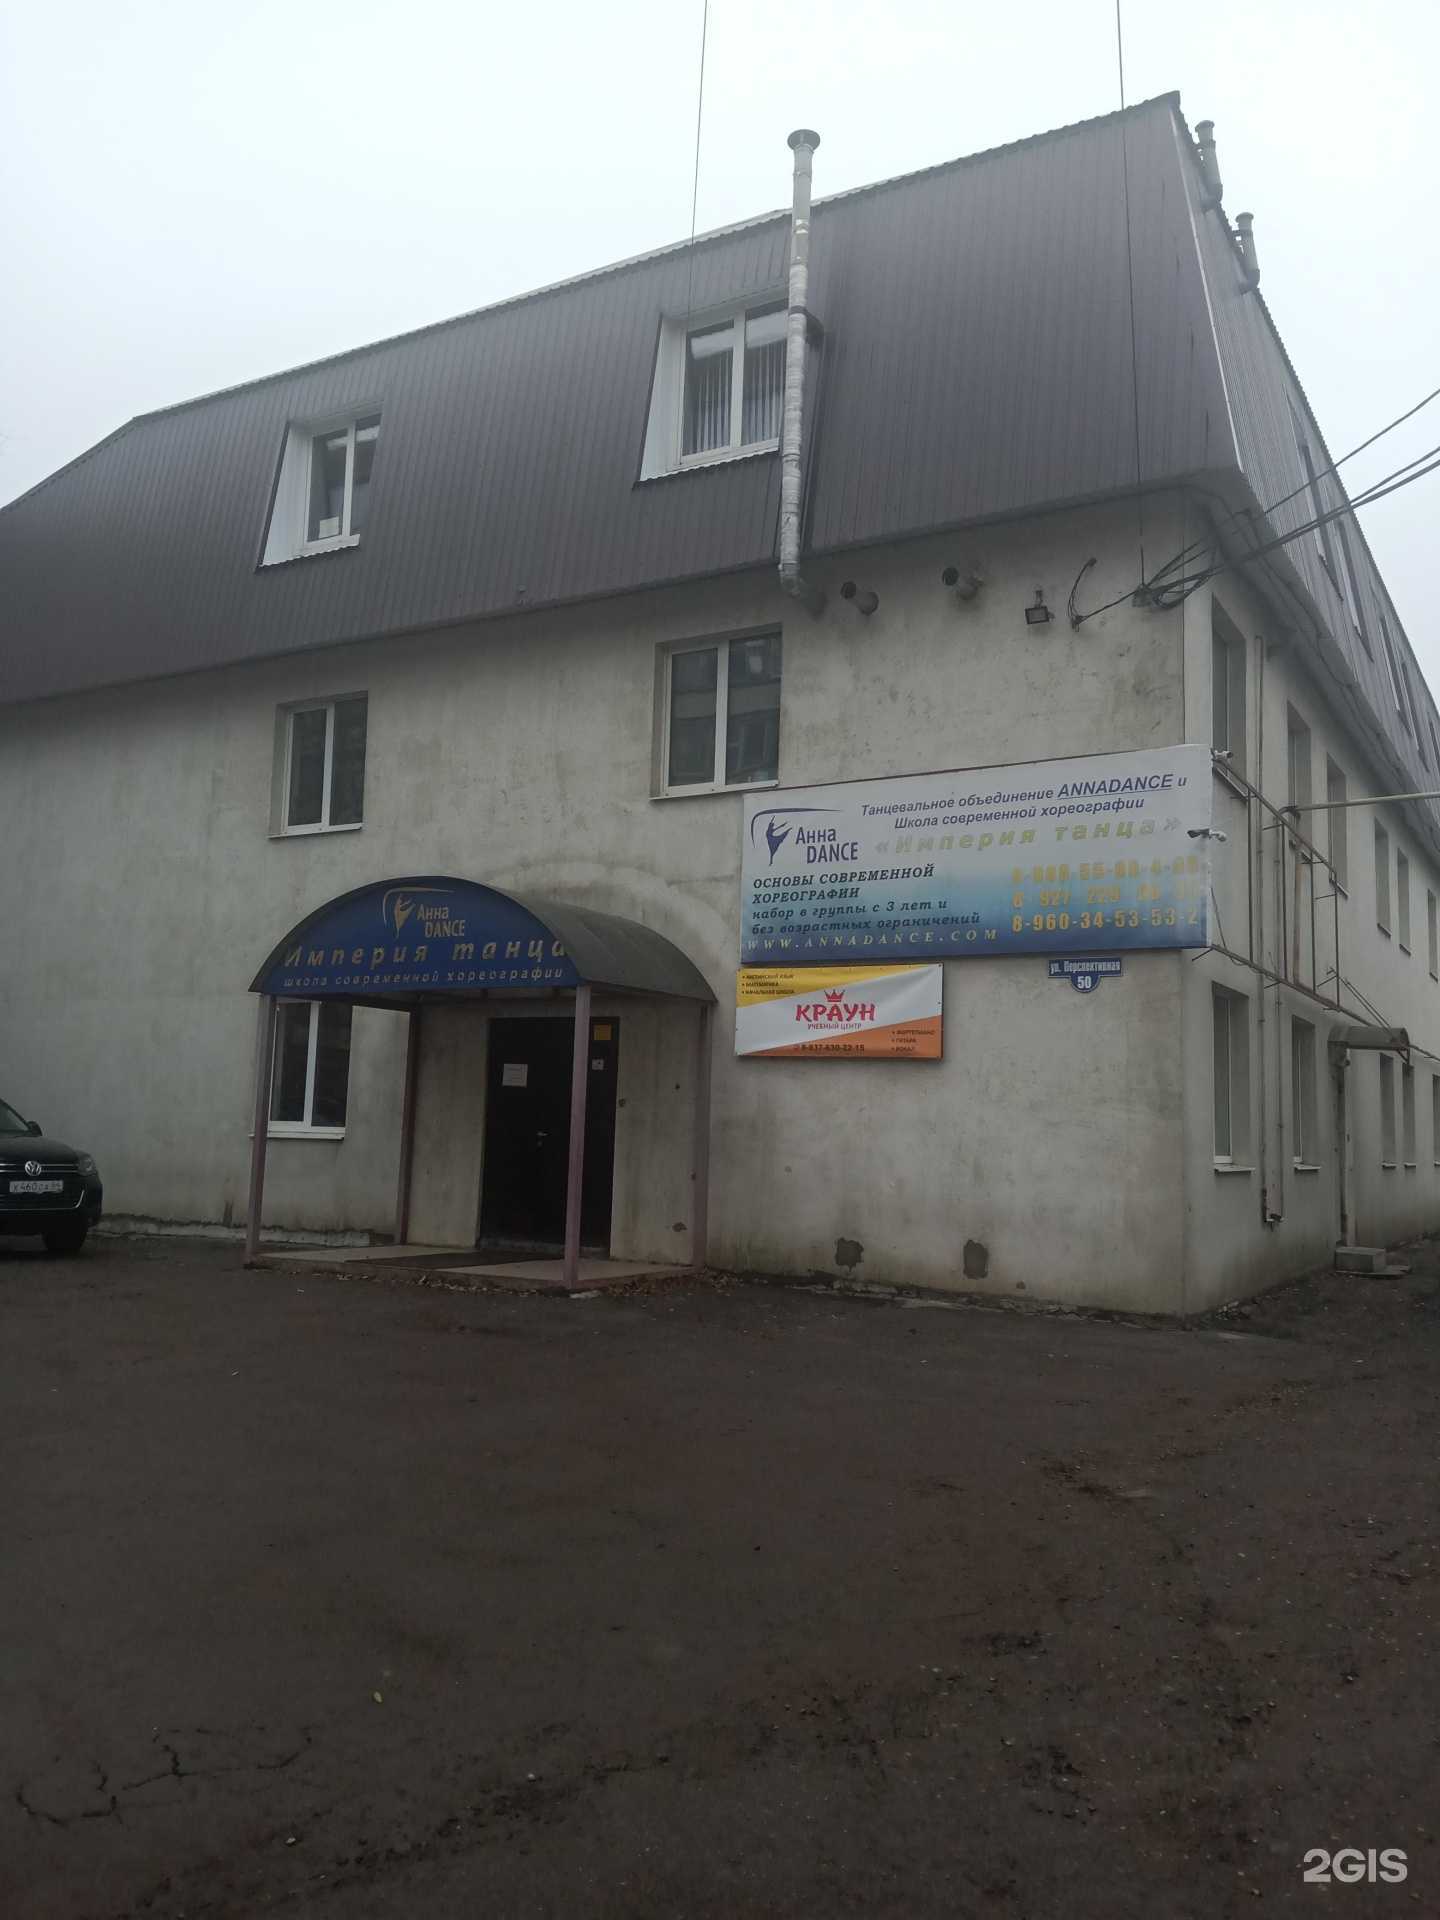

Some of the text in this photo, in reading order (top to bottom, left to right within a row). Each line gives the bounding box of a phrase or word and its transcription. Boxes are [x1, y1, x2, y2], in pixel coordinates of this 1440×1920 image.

[861, 774, 1188, 817] Танцевальное объединение ANNADANCE и
[894, 797, 1145, 830] Школа современной хореографии
[795, 827, 837, 845] Анна
[806, 842, 859, 865] DANCE
[753, 863, 935, 889] ОСНОВЫ СОВРЕМЕННОЙ
[752, 887, 860, 905] ХОРЕОГРАФИИ
[417, 903, 449, 920] Анна
[752, 900, 948, 920] набор в группы с 3 лет и
[425, 919, 466, 938] DANCE
[751, 911, 980, 935] без возрастных ограничений
[335, 970, 440, 986] современной
[447, 966, 563, 982] хореографии
[1077, 976, 1092, 989] 50
[795, 1003, 876, 1023] КРАУН
